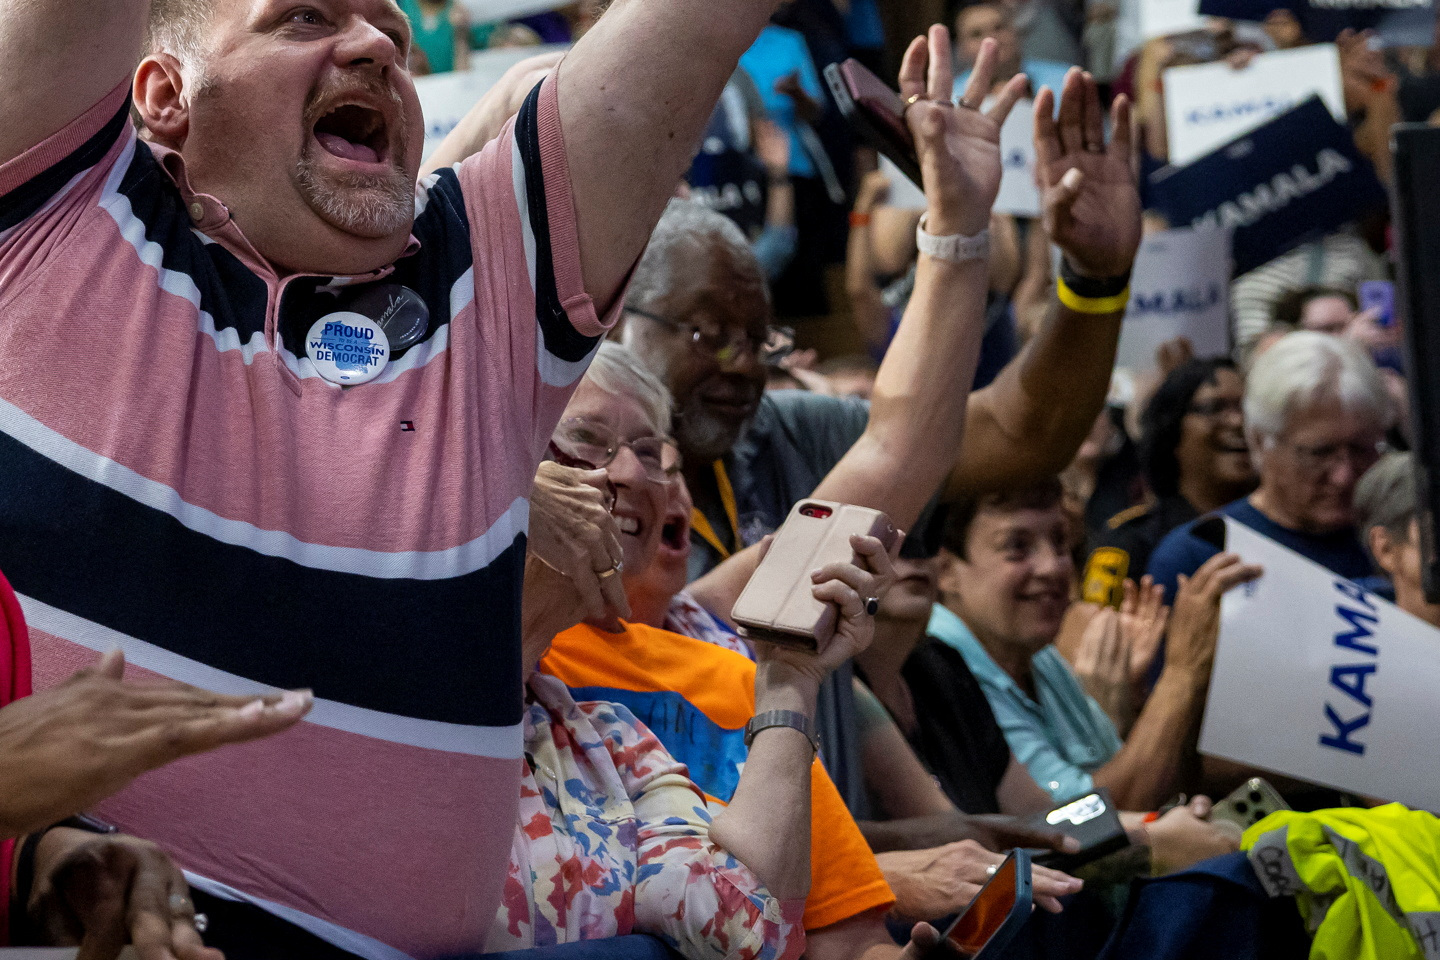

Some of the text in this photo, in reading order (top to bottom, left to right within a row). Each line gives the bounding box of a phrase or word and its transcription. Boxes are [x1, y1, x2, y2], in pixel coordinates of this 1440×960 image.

[324, 323, 374, 340] PROUD
[310, 341, 385, 356] WISCONSIN
[316, 350, 379, 367] DEMOCRAT
[1318, 581, 1379, 757] KAMA
